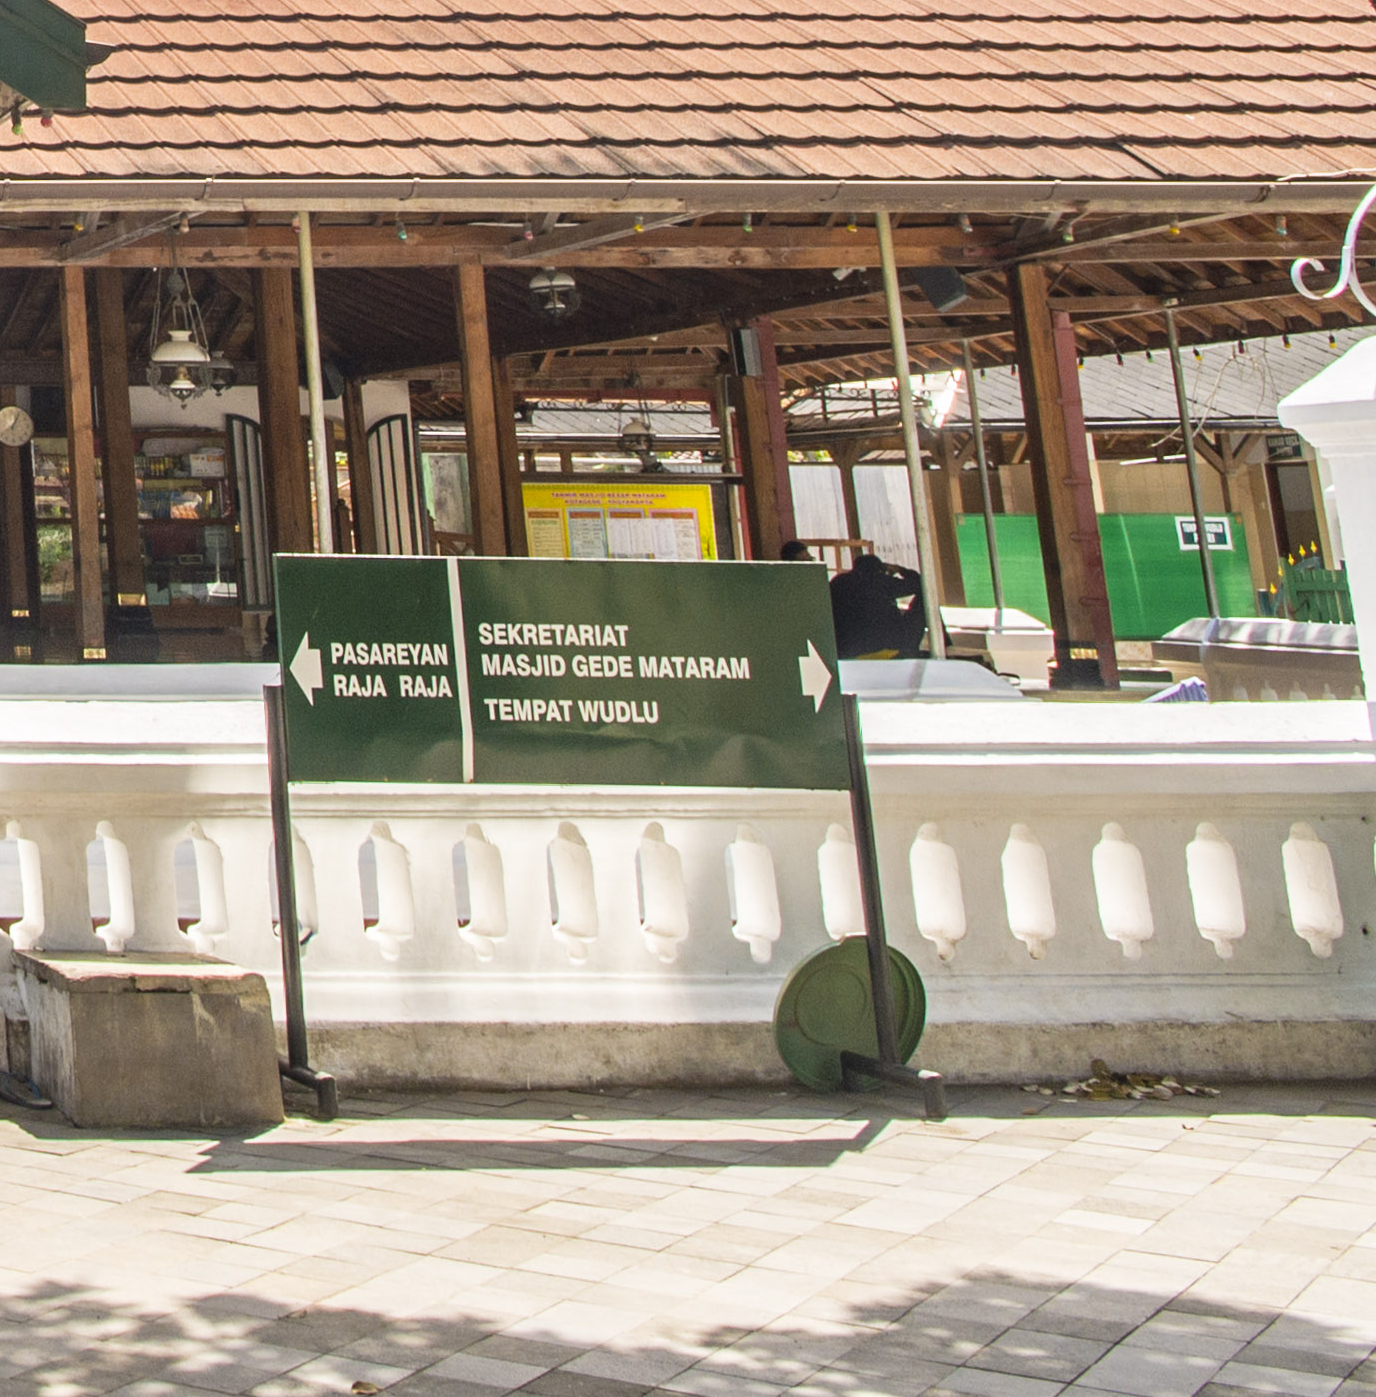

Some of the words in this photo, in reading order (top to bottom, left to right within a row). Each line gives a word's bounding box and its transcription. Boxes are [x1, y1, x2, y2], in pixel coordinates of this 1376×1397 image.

[478, 623, 628, 647] SEKRETARIAT
[331, 642, 448, 665] PASAREYAN
[482, 654, 567, 678] MASJID
[572, 655, 633, 679] GEDE
[638, 656, 750, 680] MATARAM
[333, 674, 387, 698] RAJA
[400, 674, 453, 698] RAJA
[484, 698, 572, 722] TEMPAT
[578, 699, 659, 723] WUDLU
